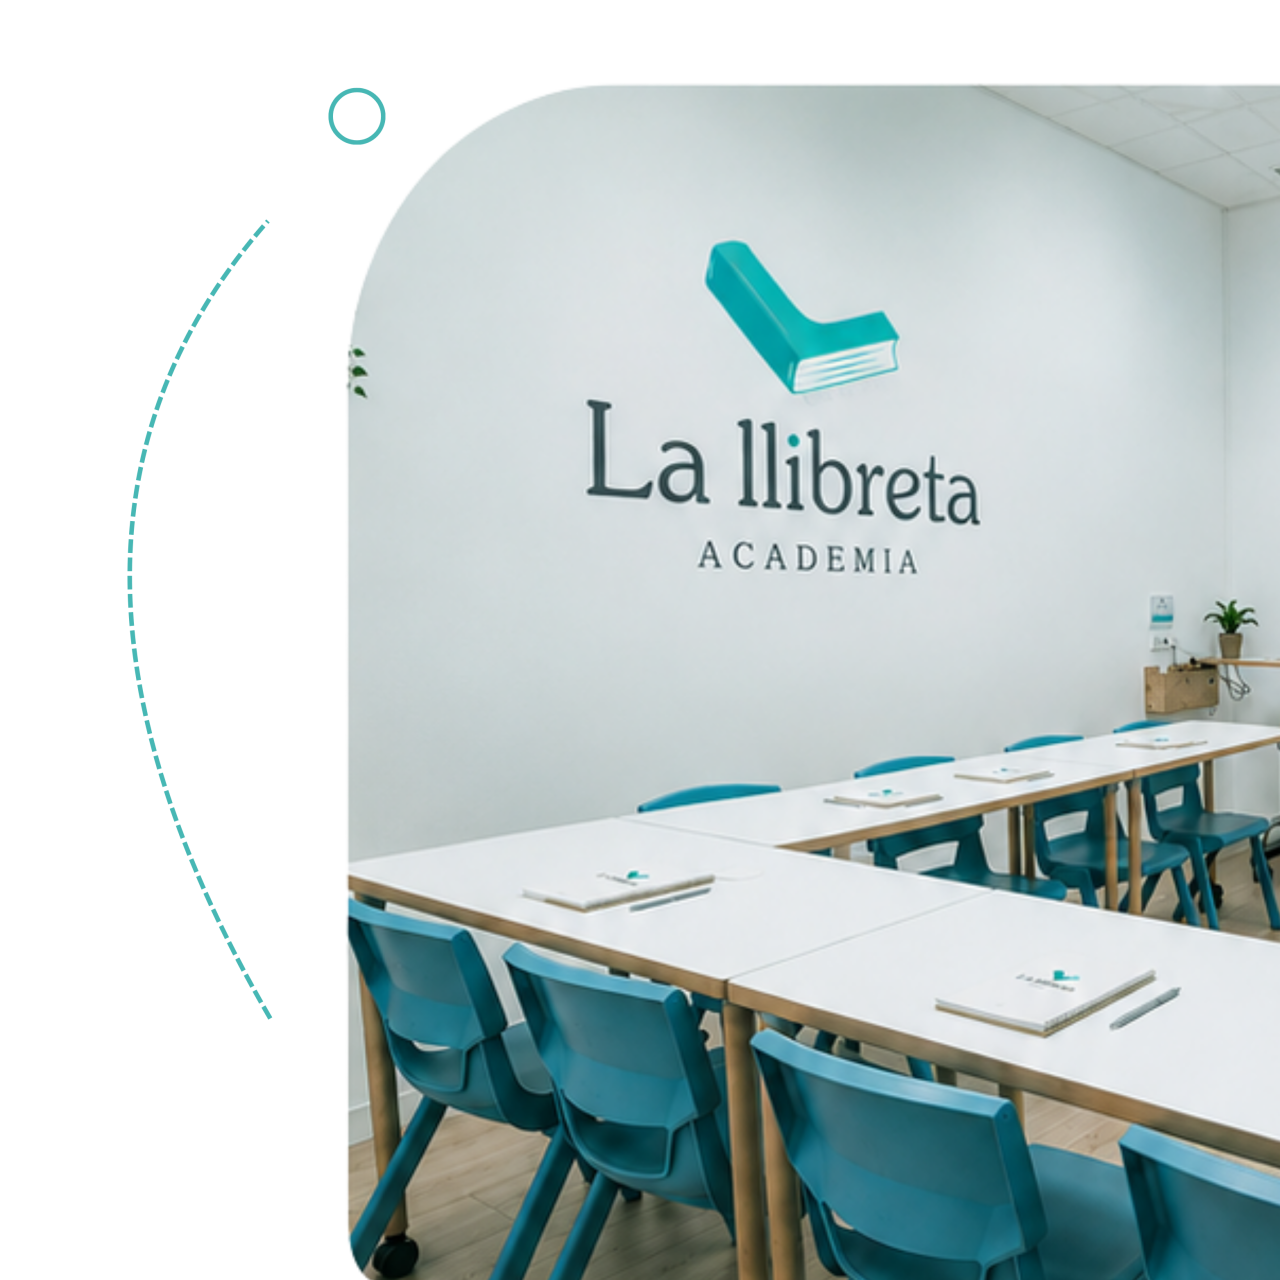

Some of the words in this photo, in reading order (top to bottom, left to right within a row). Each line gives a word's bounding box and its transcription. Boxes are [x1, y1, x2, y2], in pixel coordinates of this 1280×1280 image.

[587, 399, 710, 505] La
[737, 418, 981, 526] llibreta
[698, 540, 918, 575] ACADEMIA
